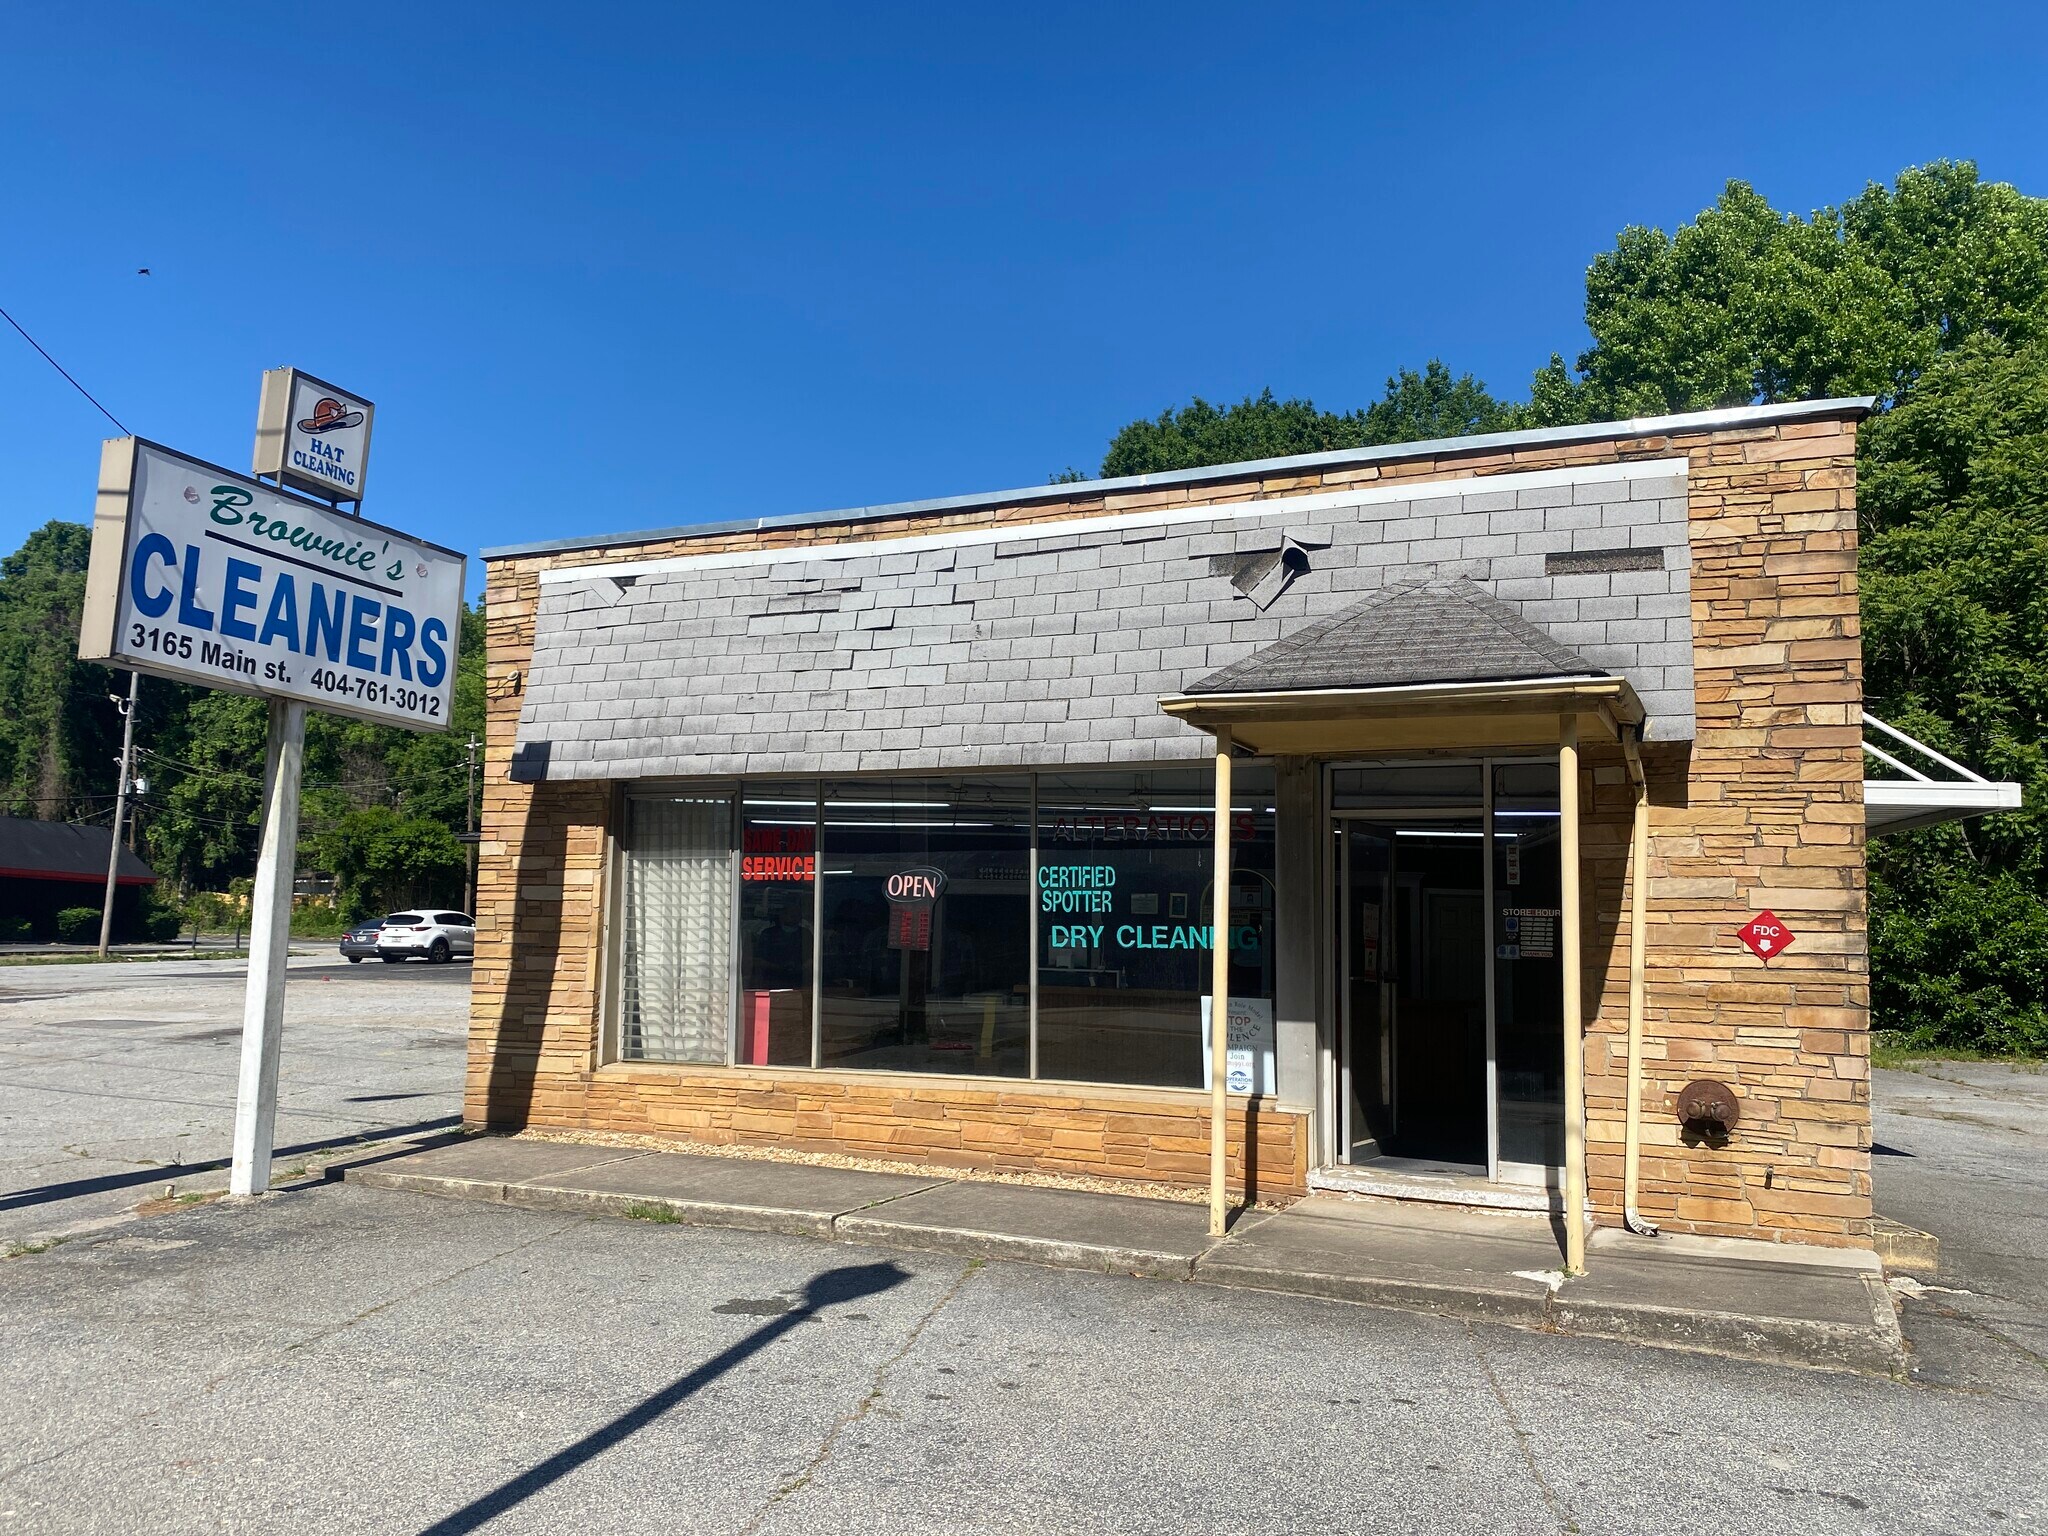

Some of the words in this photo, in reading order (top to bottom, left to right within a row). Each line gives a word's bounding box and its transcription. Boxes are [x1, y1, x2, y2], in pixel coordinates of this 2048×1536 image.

[310, 437, 344, 463] HAT
[293, 450, 355, 486] CLEANING
[209, 485, 405, 581] Brownie's
[131, 533, 448, 688] CLEANERS
[130, 623, 193, 659] 3165
[201, 640, 257, 676] Main
[264, 659, 292, 684] st.
[310, 667, 440, 717] 404-761-3012
[744, 828, 781, 852] SAME
[787, 828, 815, 852] DAY
[1052, 814, 1257, 842] ALTERATIOS
[742, 856, 815, 881] SERVICE
[1038, 865, 1117, 889] CERTIFIED
[887, 874, 936, 898] OPEN
[1041, 889, 1113, 913] SPOTTER
[1502, 908, 1532, 916] STORE
[1535, 909, 1561, 917] HOUR
[1051, 925, 1105, 949] DRY
[1753, 925, 1779, 937] FDC
[1227, 1024, 1261, 1042] LENCE
[1228, 1016, 1251, 1026] TOP
[1227, 1044, 1258, 1052] MPAIGN
[1230, 1052, 1245, 1060] Join
